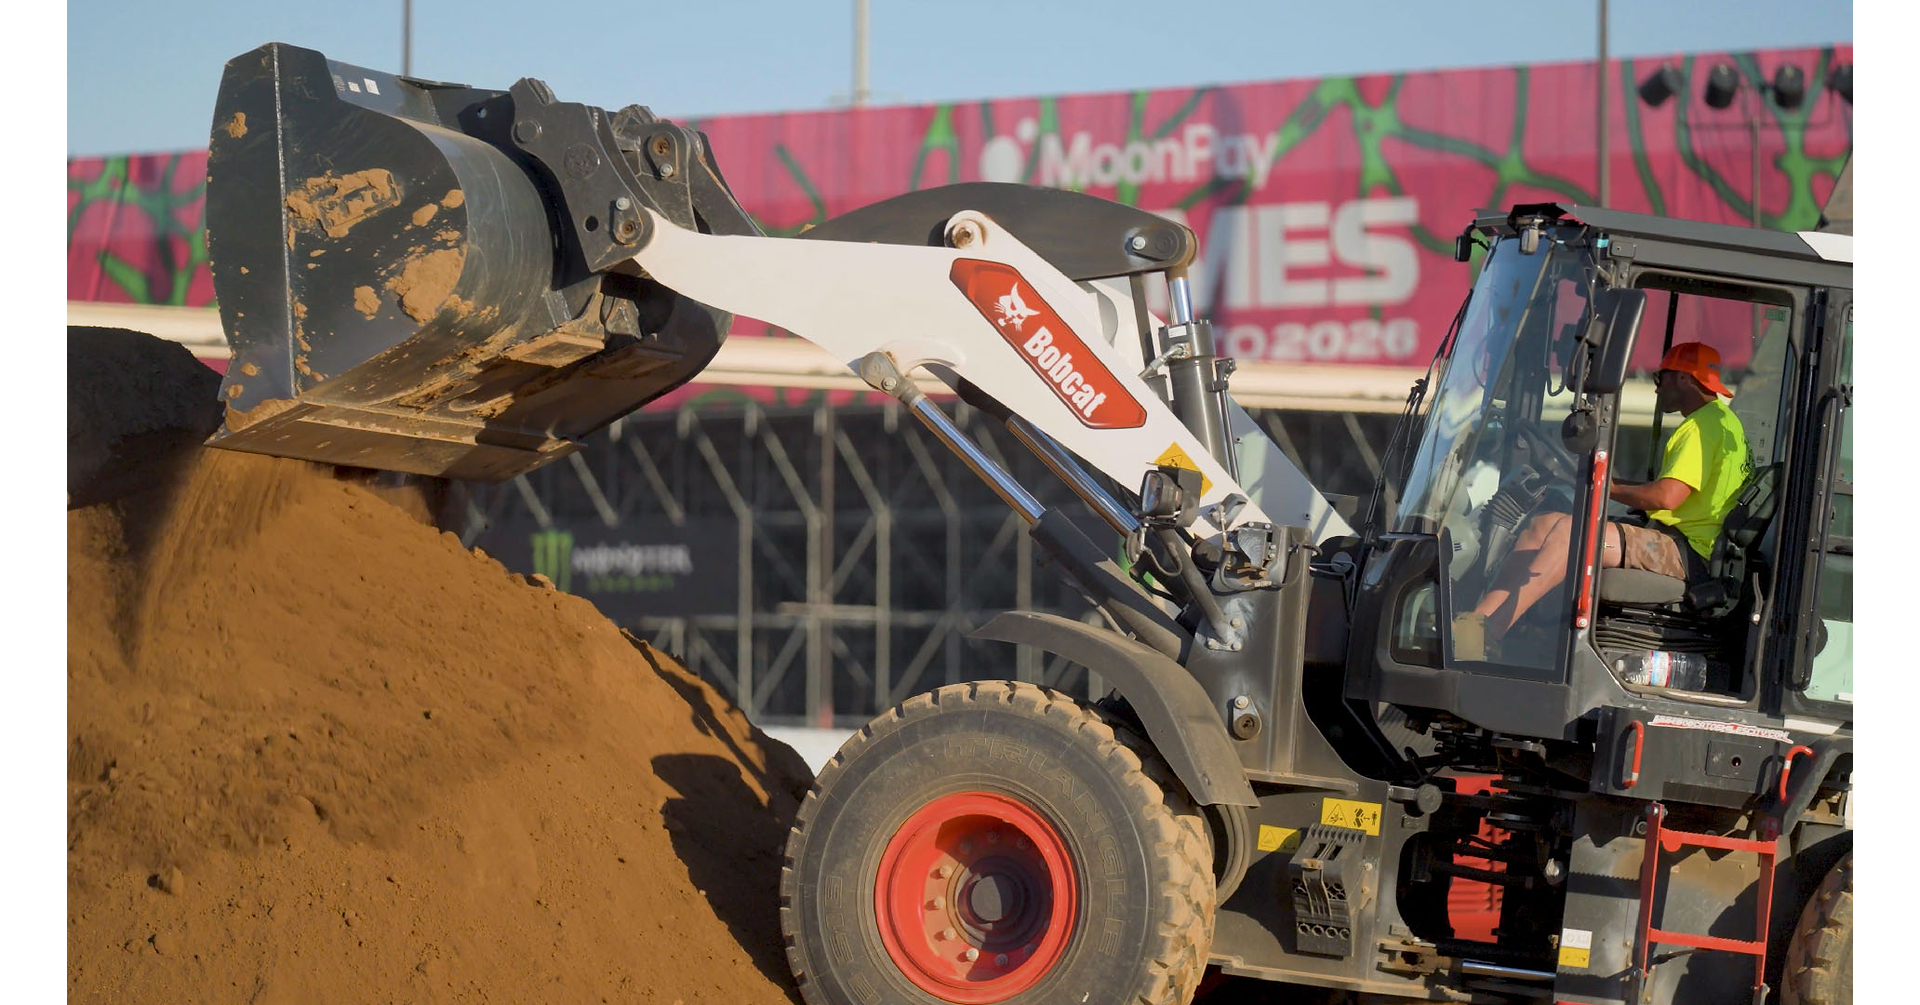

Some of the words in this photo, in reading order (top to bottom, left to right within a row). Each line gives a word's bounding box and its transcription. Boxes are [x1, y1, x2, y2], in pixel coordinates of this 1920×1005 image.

[1041, 123, 1279, 190] MoonPay
[1146, 199, 1419, 310] MES
[1023, 326, 1107, 418] Bobcat
[1272, 318, 1419, 360] 2026
